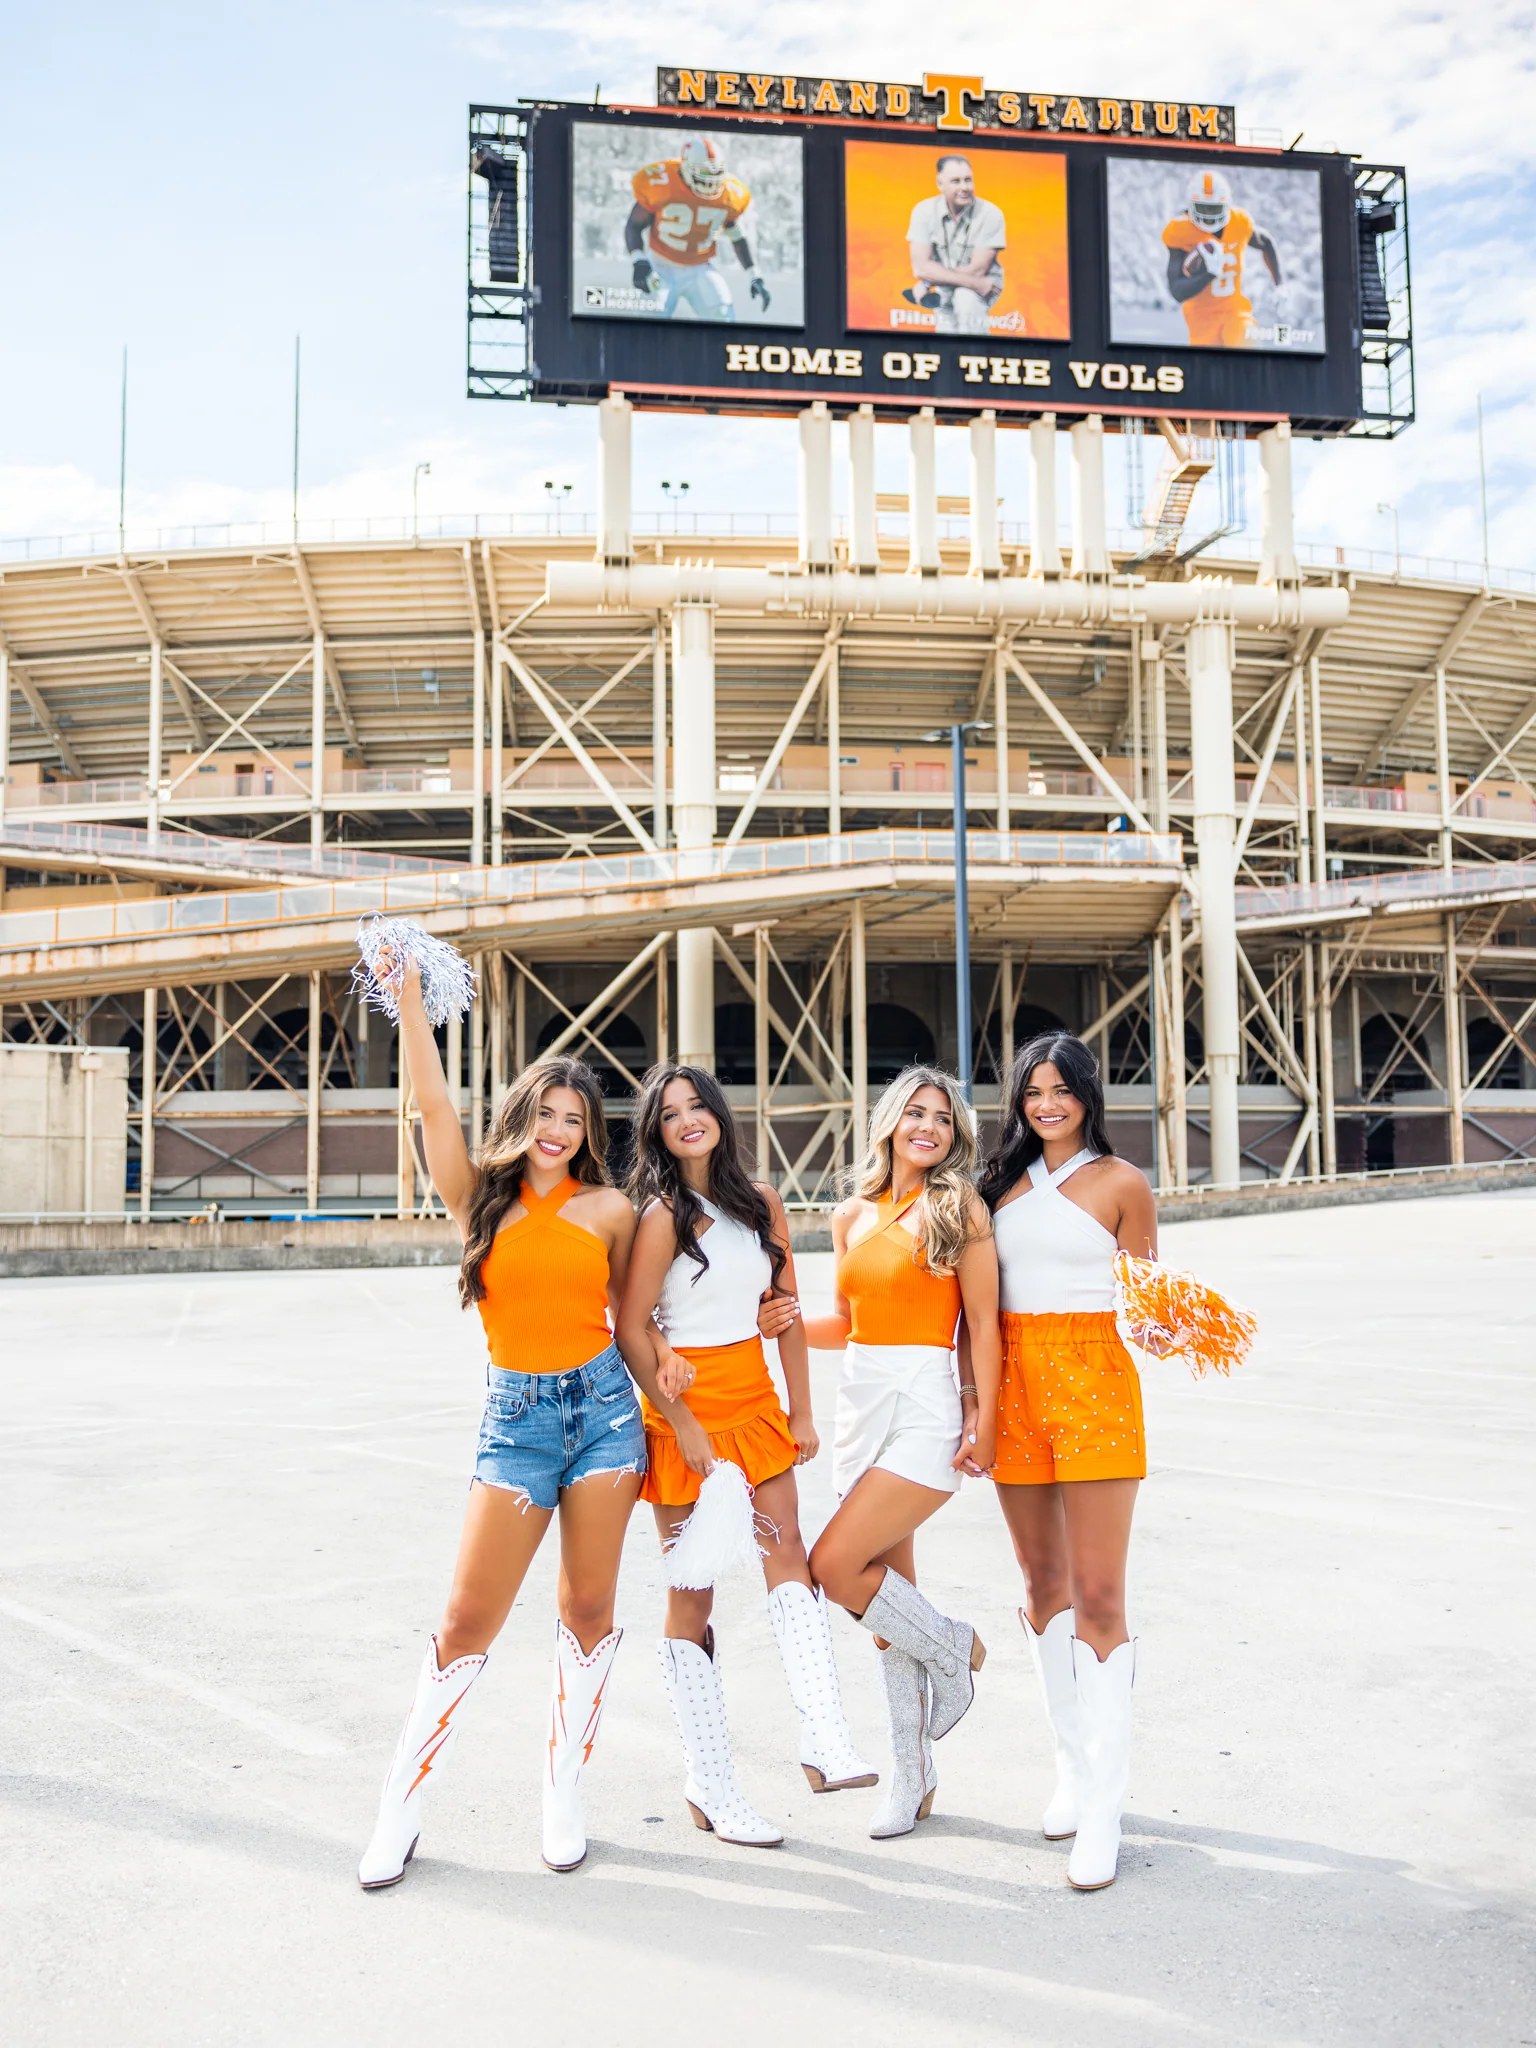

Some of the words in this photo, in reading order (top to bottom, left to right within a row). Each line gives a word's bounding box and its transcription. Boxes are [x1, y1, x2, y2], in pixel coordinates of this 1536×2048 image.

[678, 69, 911, 117] NEYLAND
[922, 72, 985, 131] T
[998, 93, 1220, 137] STADIUM
[658, 202, 728, 255] 27
[726, 344, 863, 377] HOME
[882, 352, 941, 380] OF
[959, 355, 1051, 386] THE
[1069, 361, 1184, 393] VOLS
